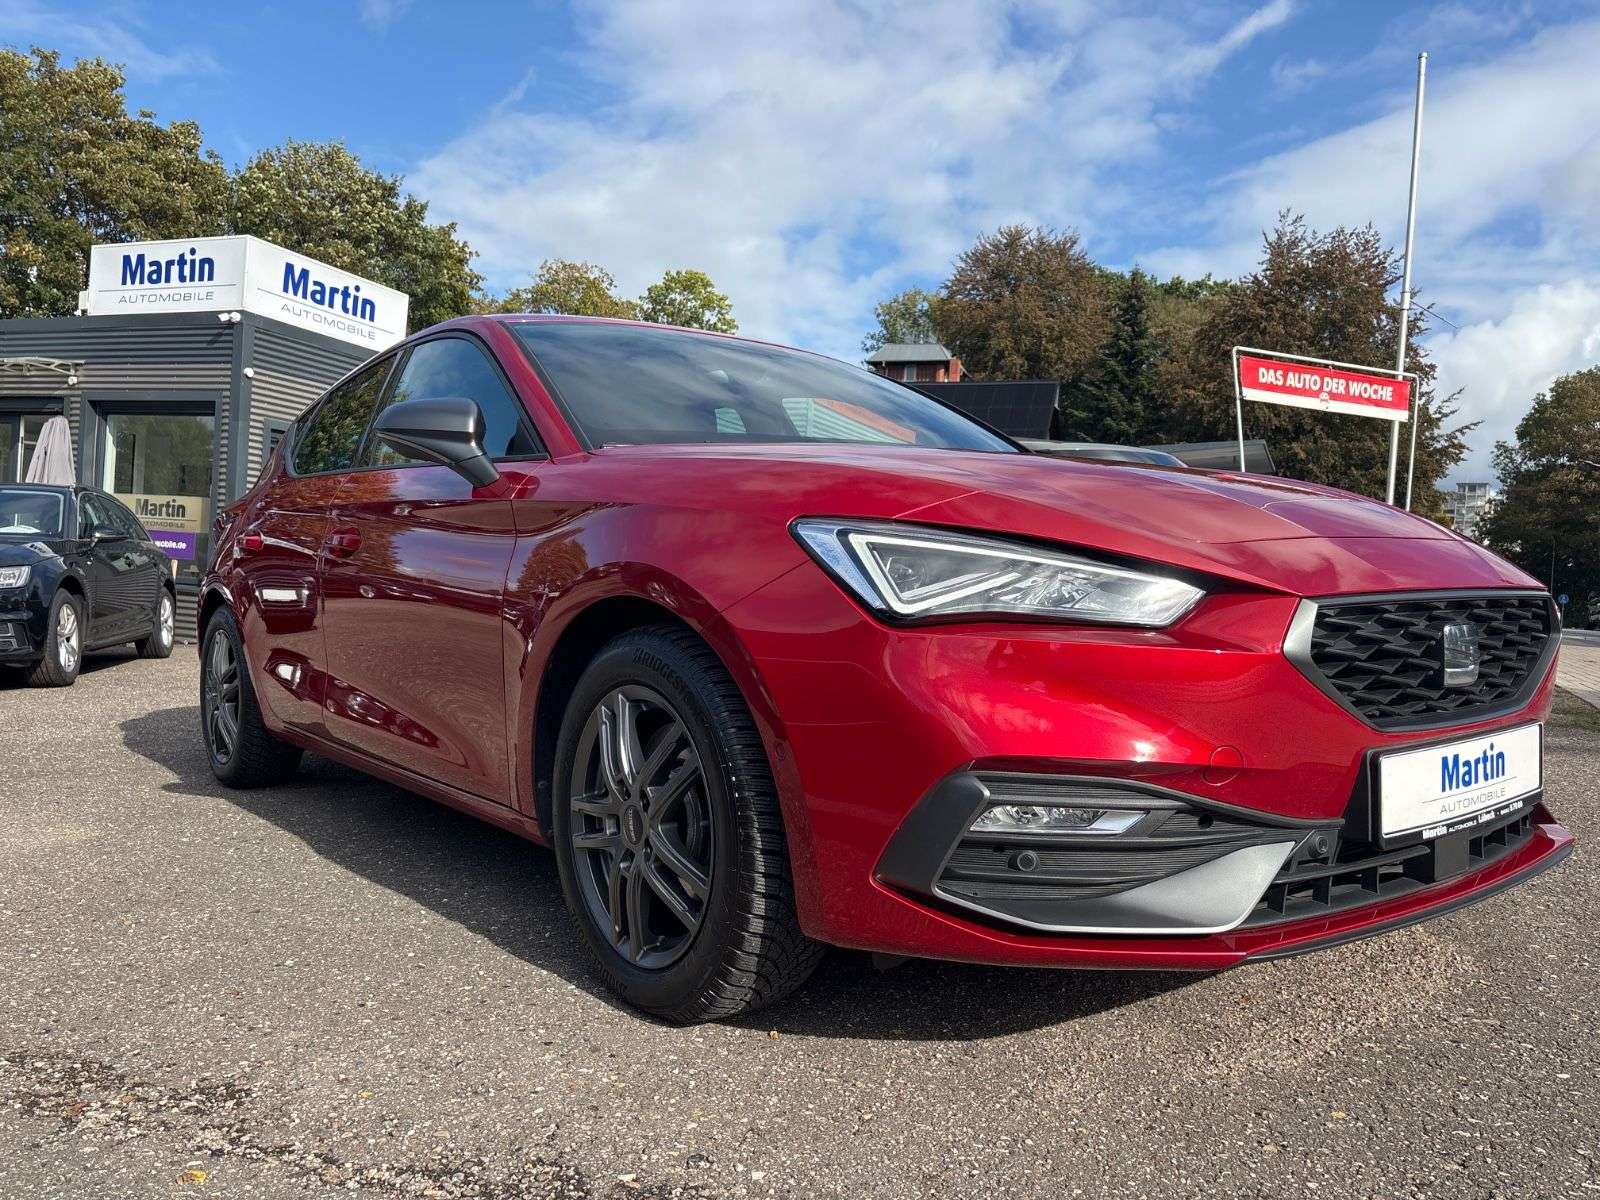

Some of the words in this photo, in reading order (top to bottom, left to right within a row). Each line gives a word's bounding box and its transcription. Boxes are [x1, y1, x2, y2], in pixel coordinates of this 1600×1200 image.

[121, 247, 214, 286] Martin
[118, 291, 214, 304] AUTOMOBILE
[282, 262, 376, 323] Martin
[280, 303, 376, 341] AUTOMOBILE
[1258, 367, 1284, 386] DAS
[1286, 371, 1321, 391] AUTO
[1323, 377, 1346, 395] DER
[1349, 380, 1393, 402] WOCHE
[135, 498, 186, 518] Martin
[142, 520, 186, 529] TOMOBILE
[1441, 742, 1505, 793] Martin
[1439, 787, 1506, 815] AUTOMOBILE
